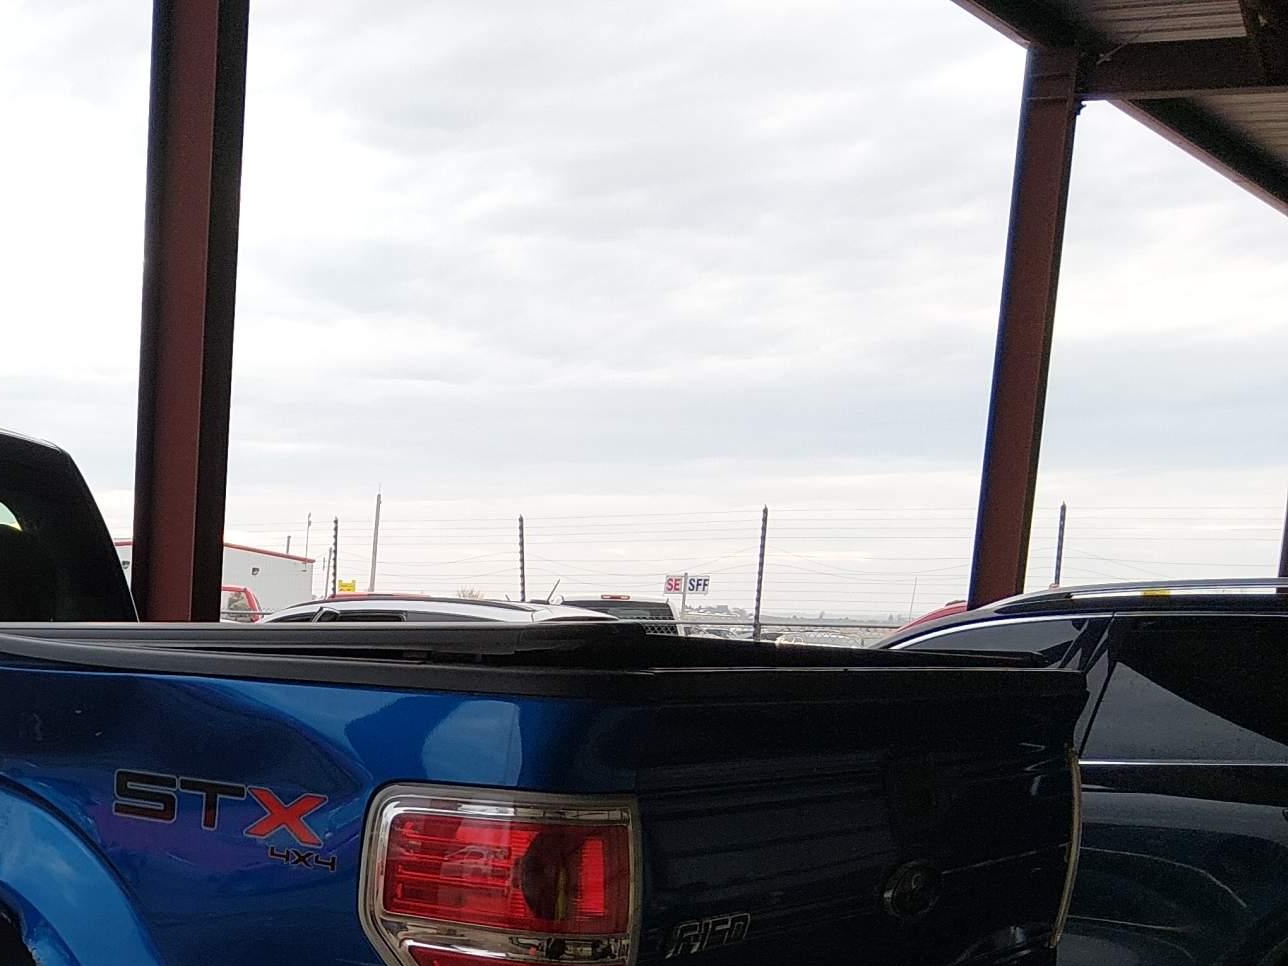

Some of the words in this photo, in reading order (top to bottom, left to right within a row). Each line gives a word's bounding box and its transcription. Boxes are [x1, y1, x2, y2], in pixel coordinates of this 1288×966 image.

[666, 578, 682, 592] SE
[688, 578, 710, 592] SFF
[113, 768, 329, 848] STX
